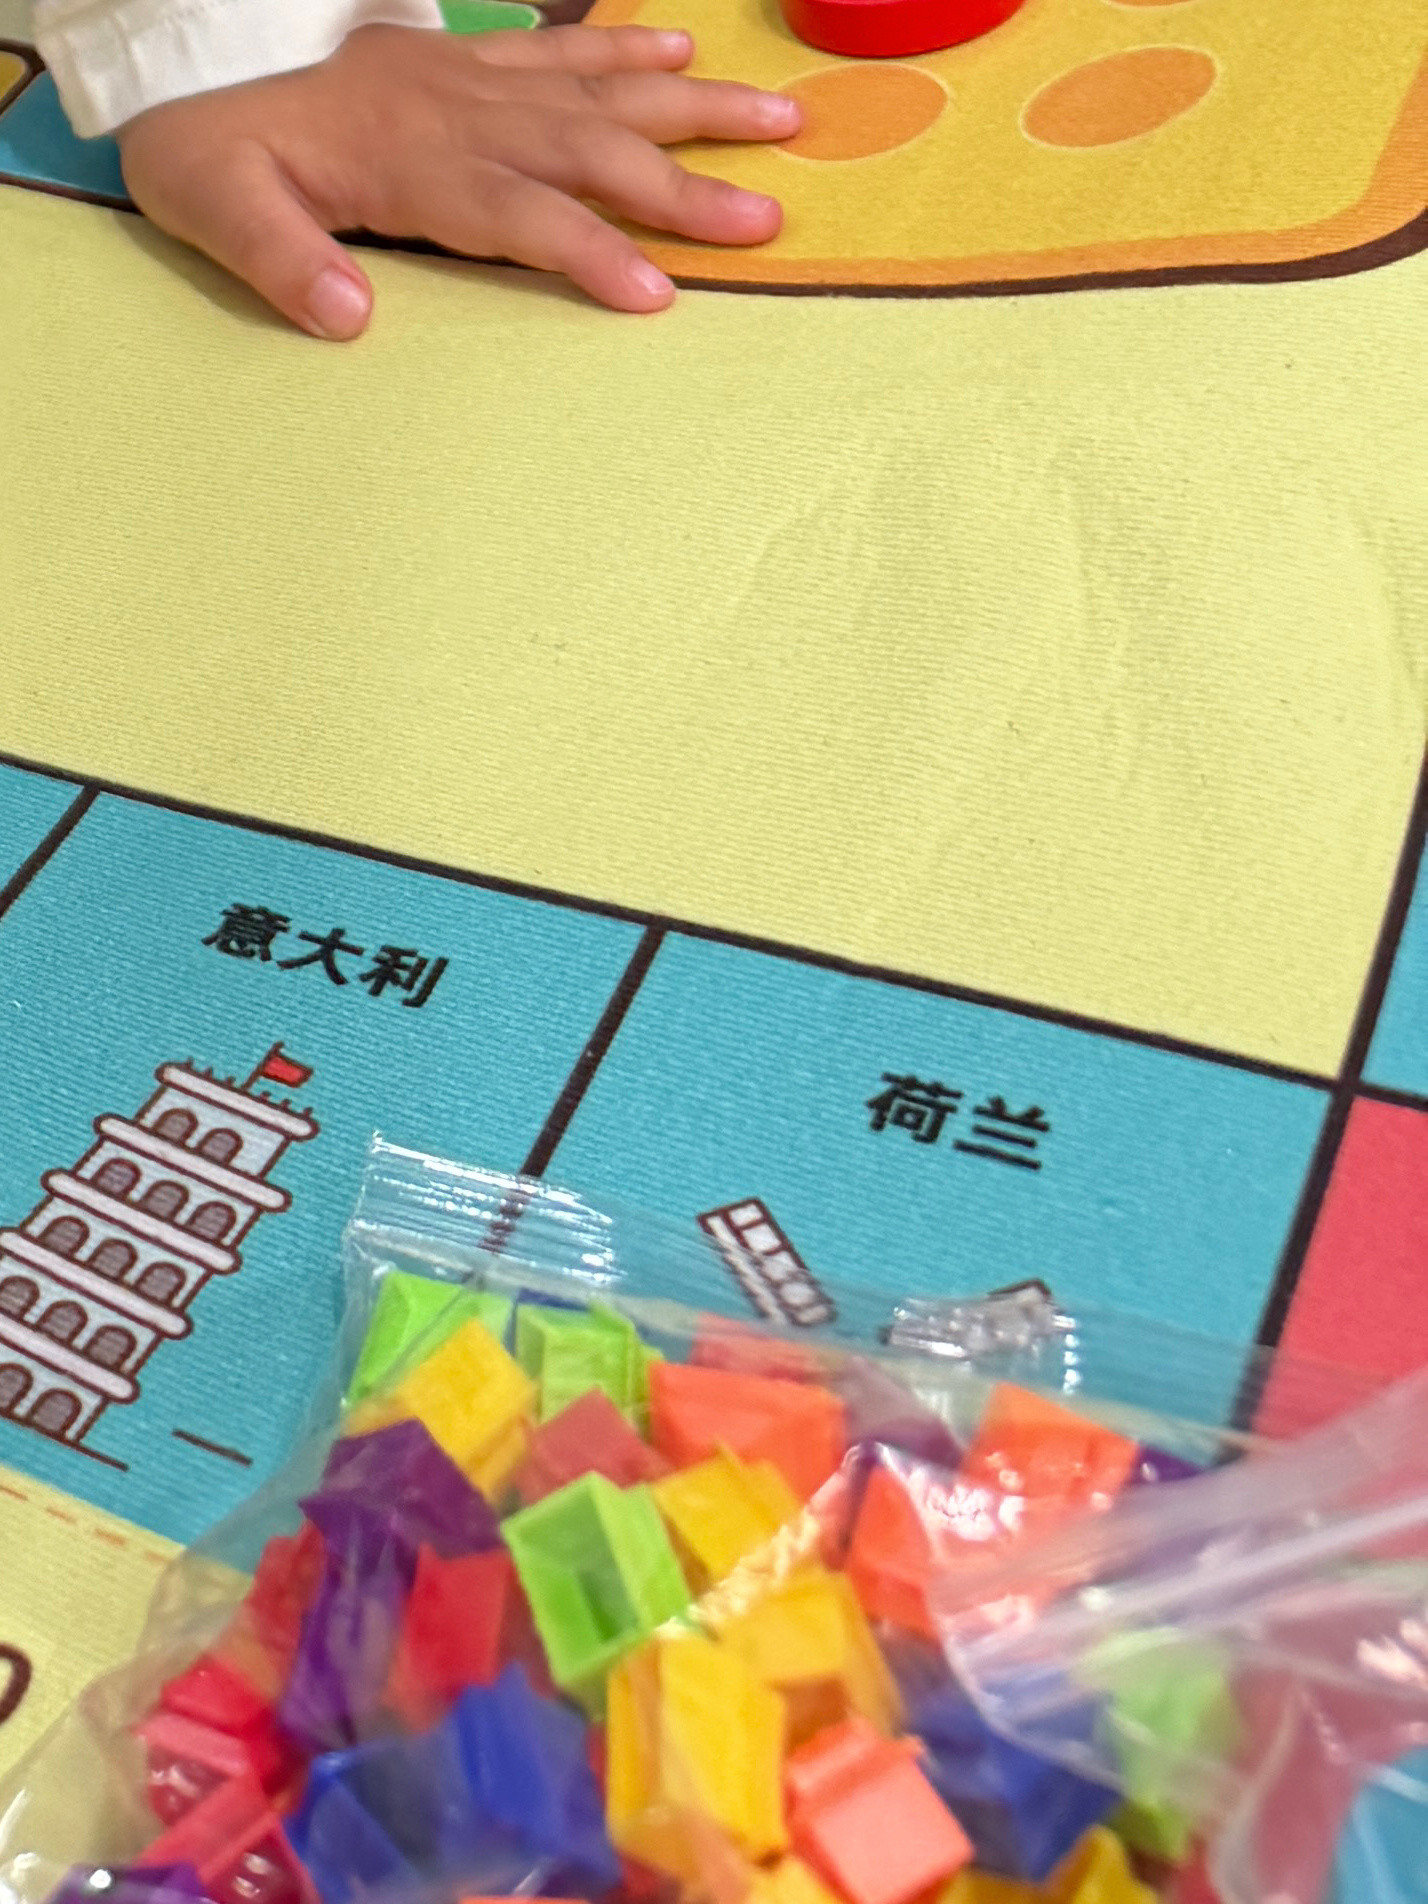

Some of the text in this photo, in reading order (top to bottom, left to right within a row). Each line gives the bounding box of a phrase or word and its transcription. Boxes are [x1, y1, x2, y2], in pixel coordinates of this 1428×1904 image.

[201, 901, 450, 1010] 意大利
[864, 1072, 1051, 1170] 荷兰
